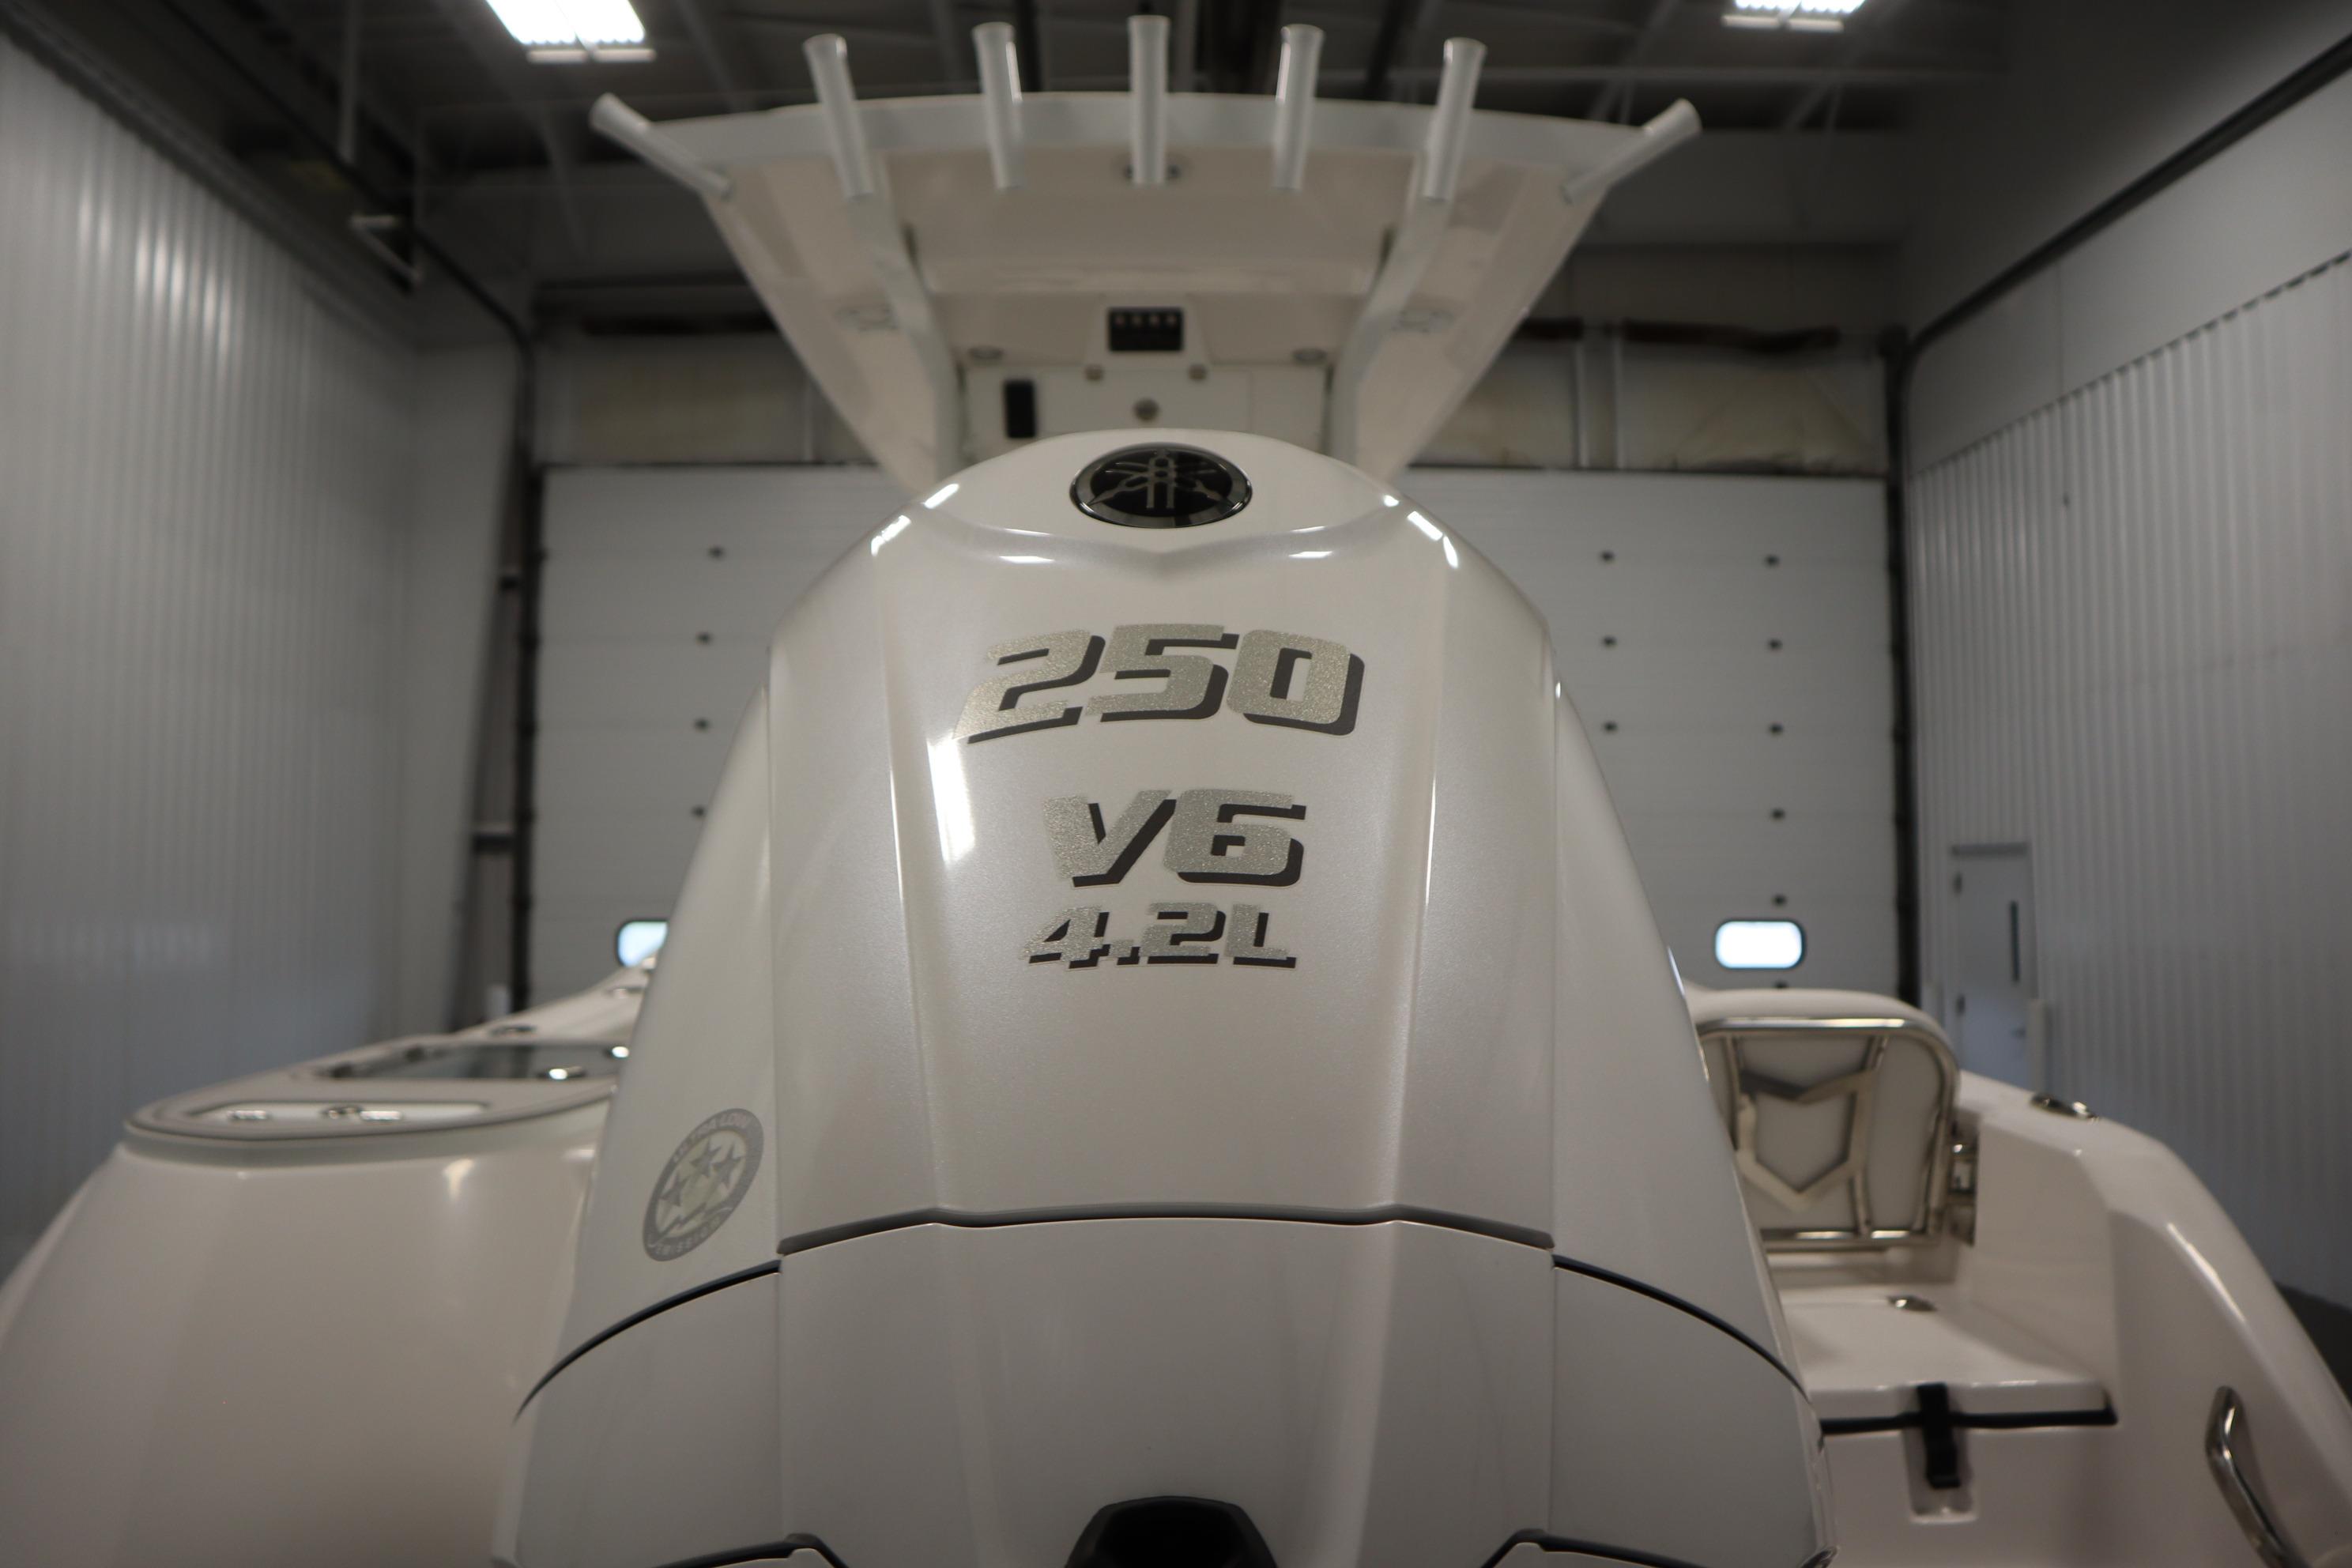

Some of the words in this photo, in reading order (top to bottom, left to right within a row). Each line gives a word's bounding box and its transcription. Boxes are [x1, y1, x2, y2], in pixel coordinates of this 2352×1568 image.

[952, 623, 1366, 744] 250
[1042, 789, 1307, 888] V6
[1019, 902, 1297, 970] 4.2L
